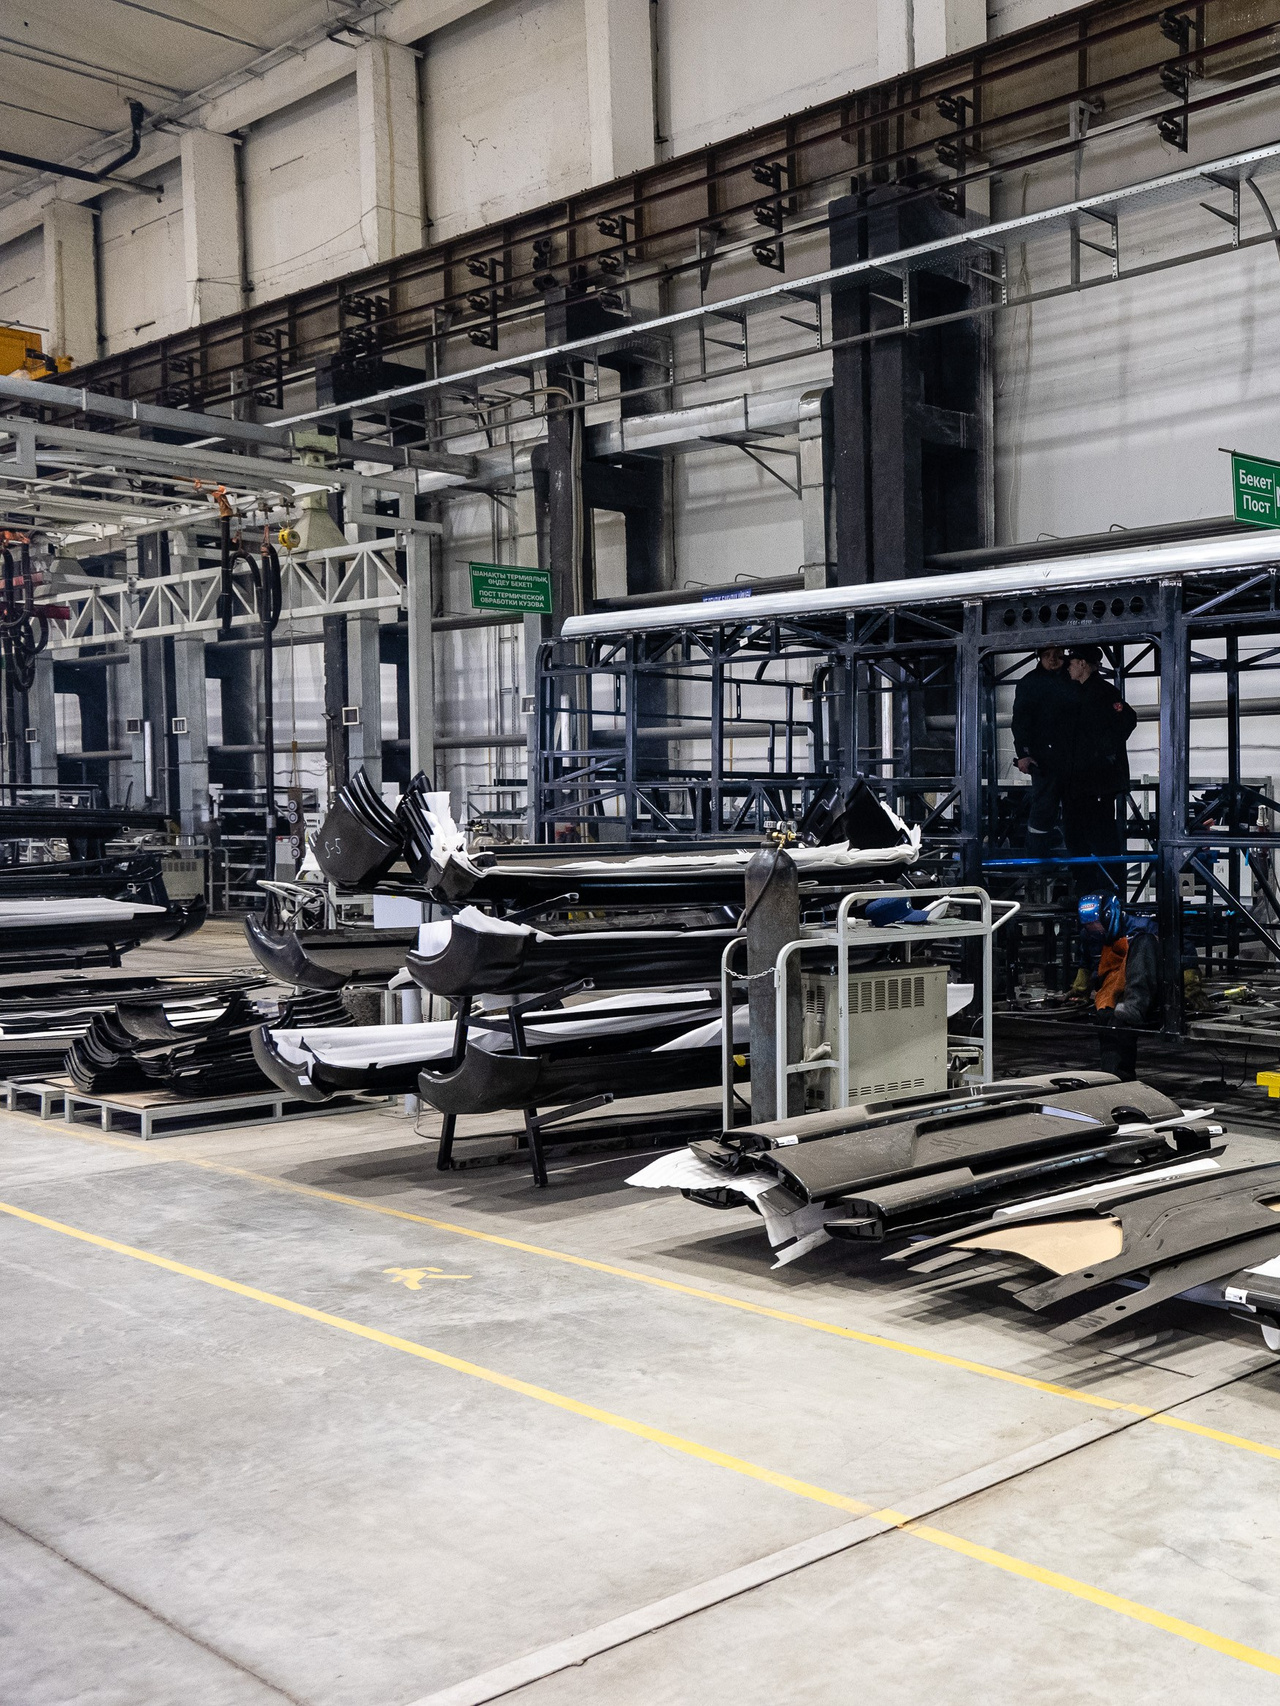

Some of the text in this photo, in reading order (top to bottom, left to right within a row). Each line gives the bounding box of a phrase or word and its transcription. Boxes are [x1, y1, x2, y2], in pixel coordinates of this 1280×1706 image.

[1239, 469, 1272, 490] Бекет
[1243, 494, 1271, 514] Пост
[511, 580, 533, 588] БЕКЕТІ
[479, 589, 545, 601] ПОСТ ТЕРМИЧЕСКОЙ
[480, 596, 544, 608] ОБРАБОТКИ КУЗОВА
